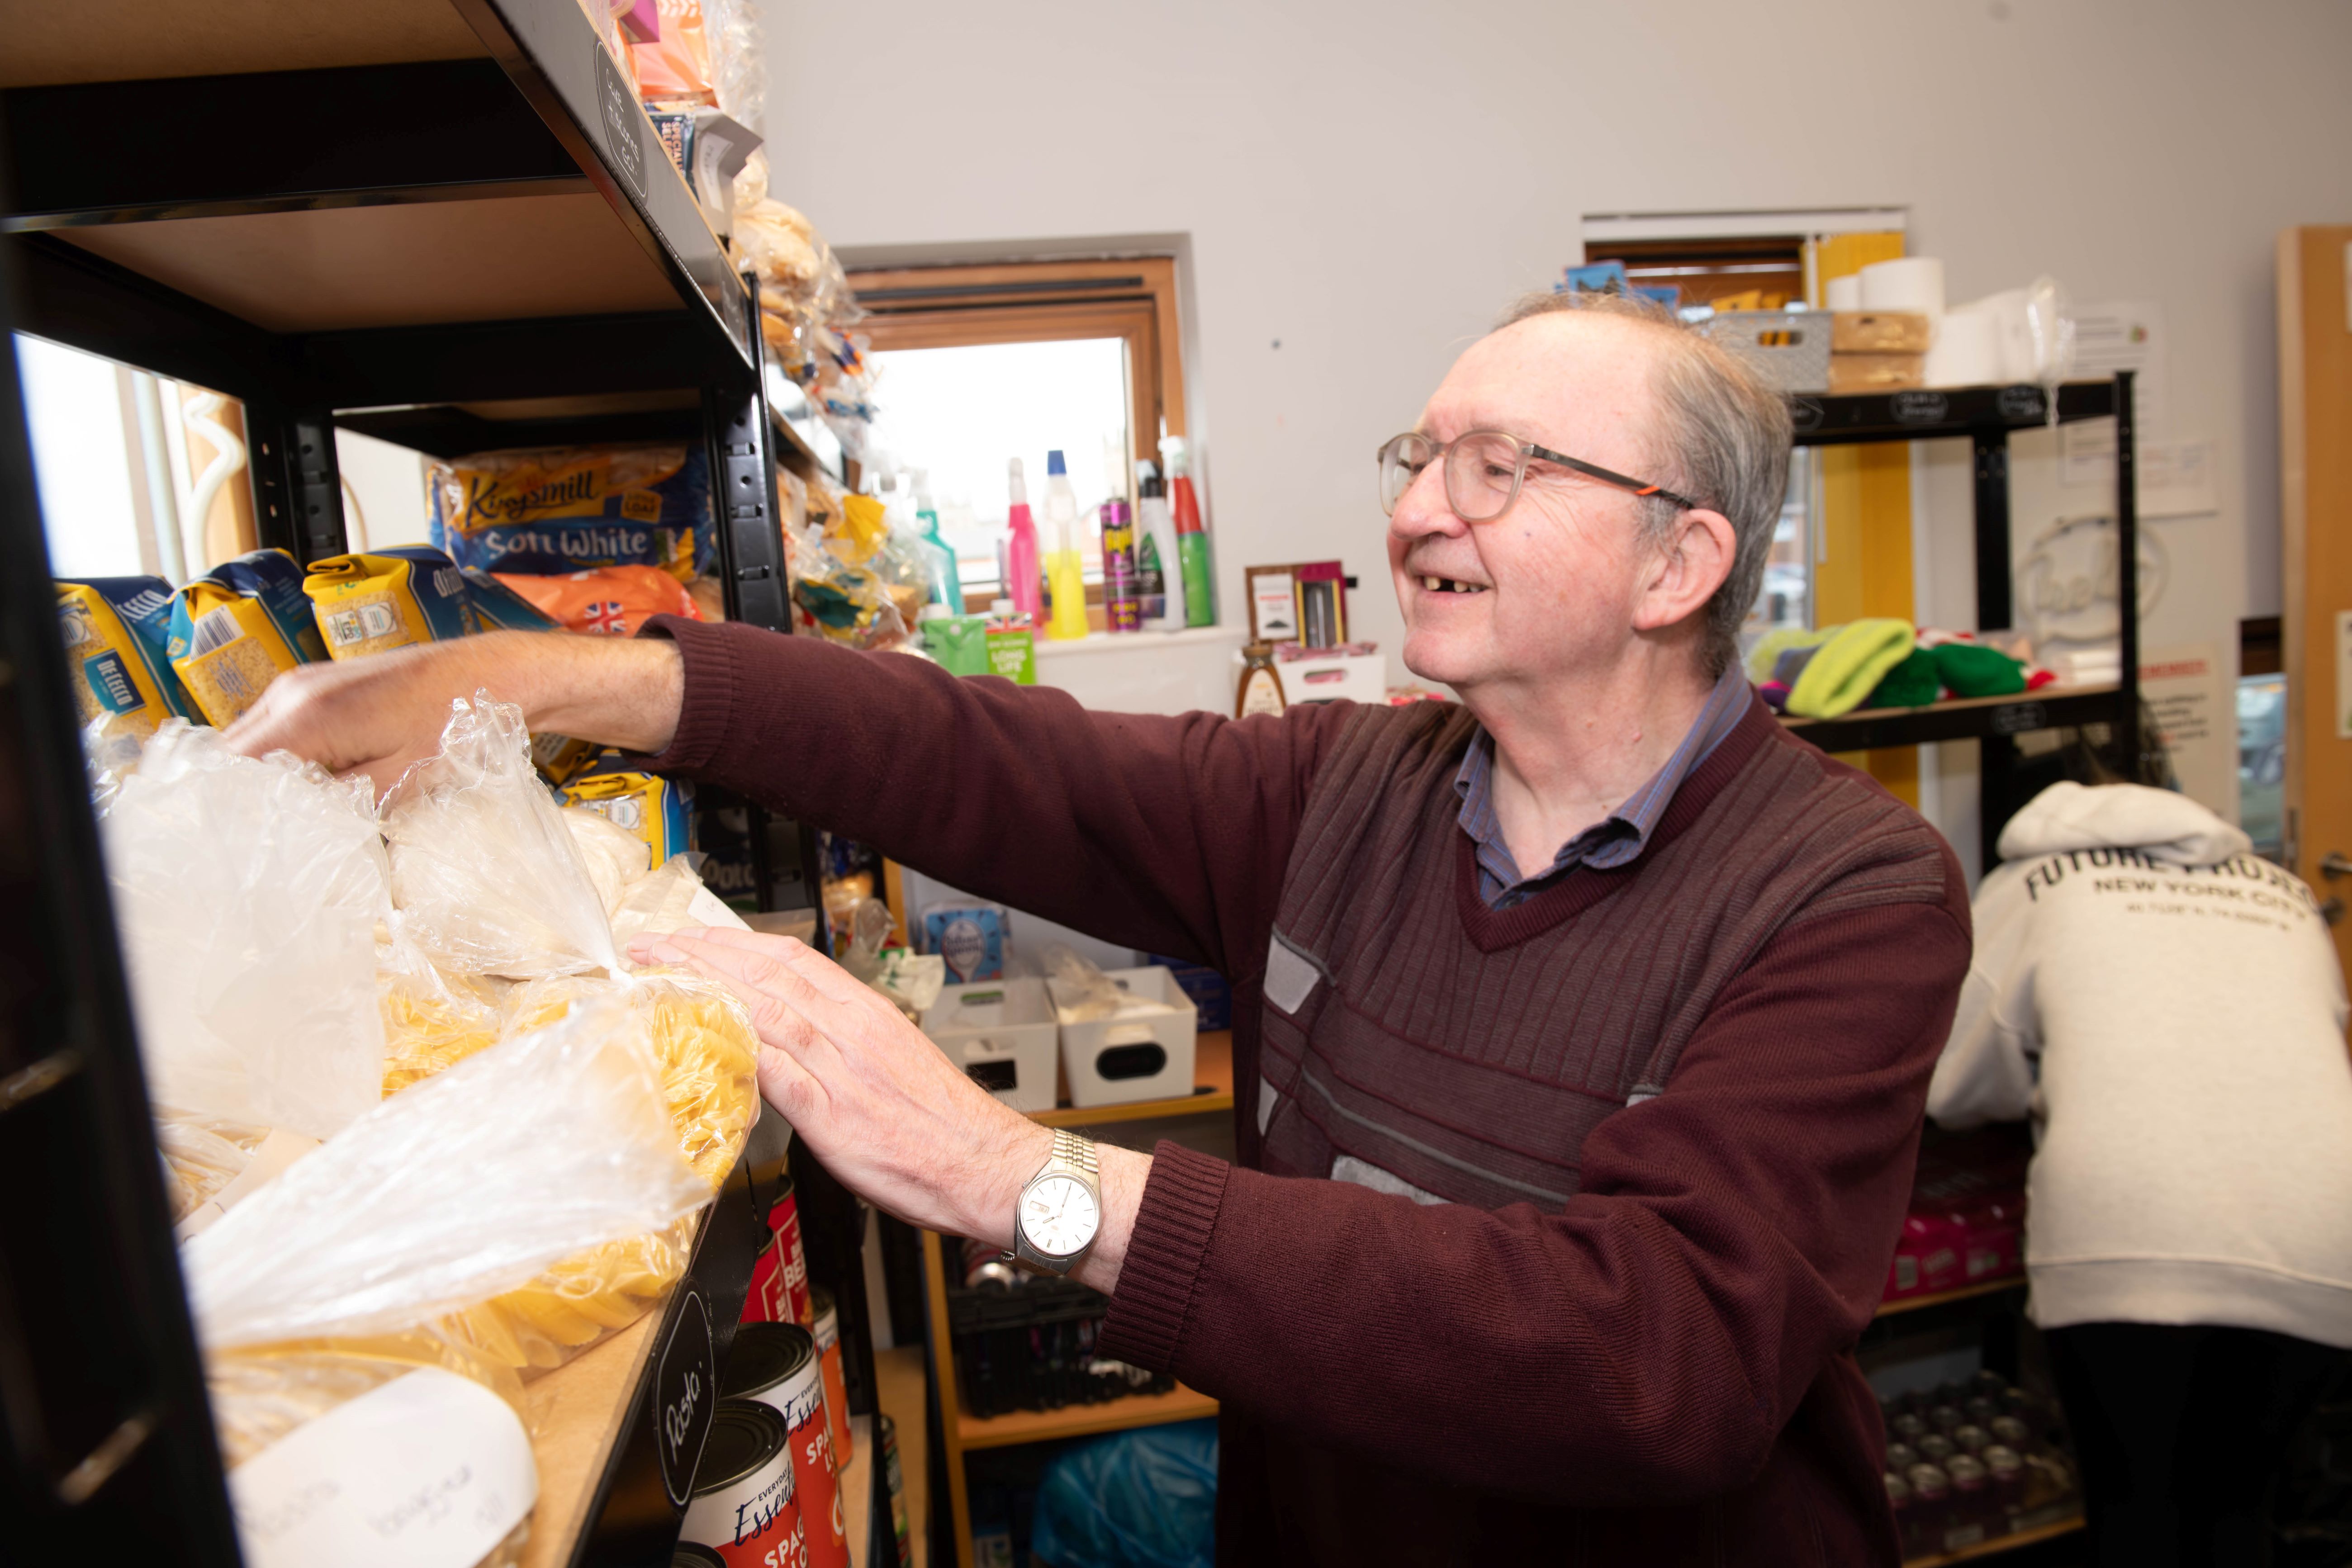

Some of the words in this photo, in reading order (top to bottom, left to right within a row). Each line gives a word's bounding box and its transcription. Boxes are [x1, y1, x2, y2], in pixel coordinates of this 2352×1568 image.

[465, 470, 600, 527] Kingsmill
[560, 528, 648, 557] White
[2094, 876, 2156, 894] NEW
[2163, 880, 2246, 901] YORK
[758, 1466, 788, 1502] EVERYDAY
